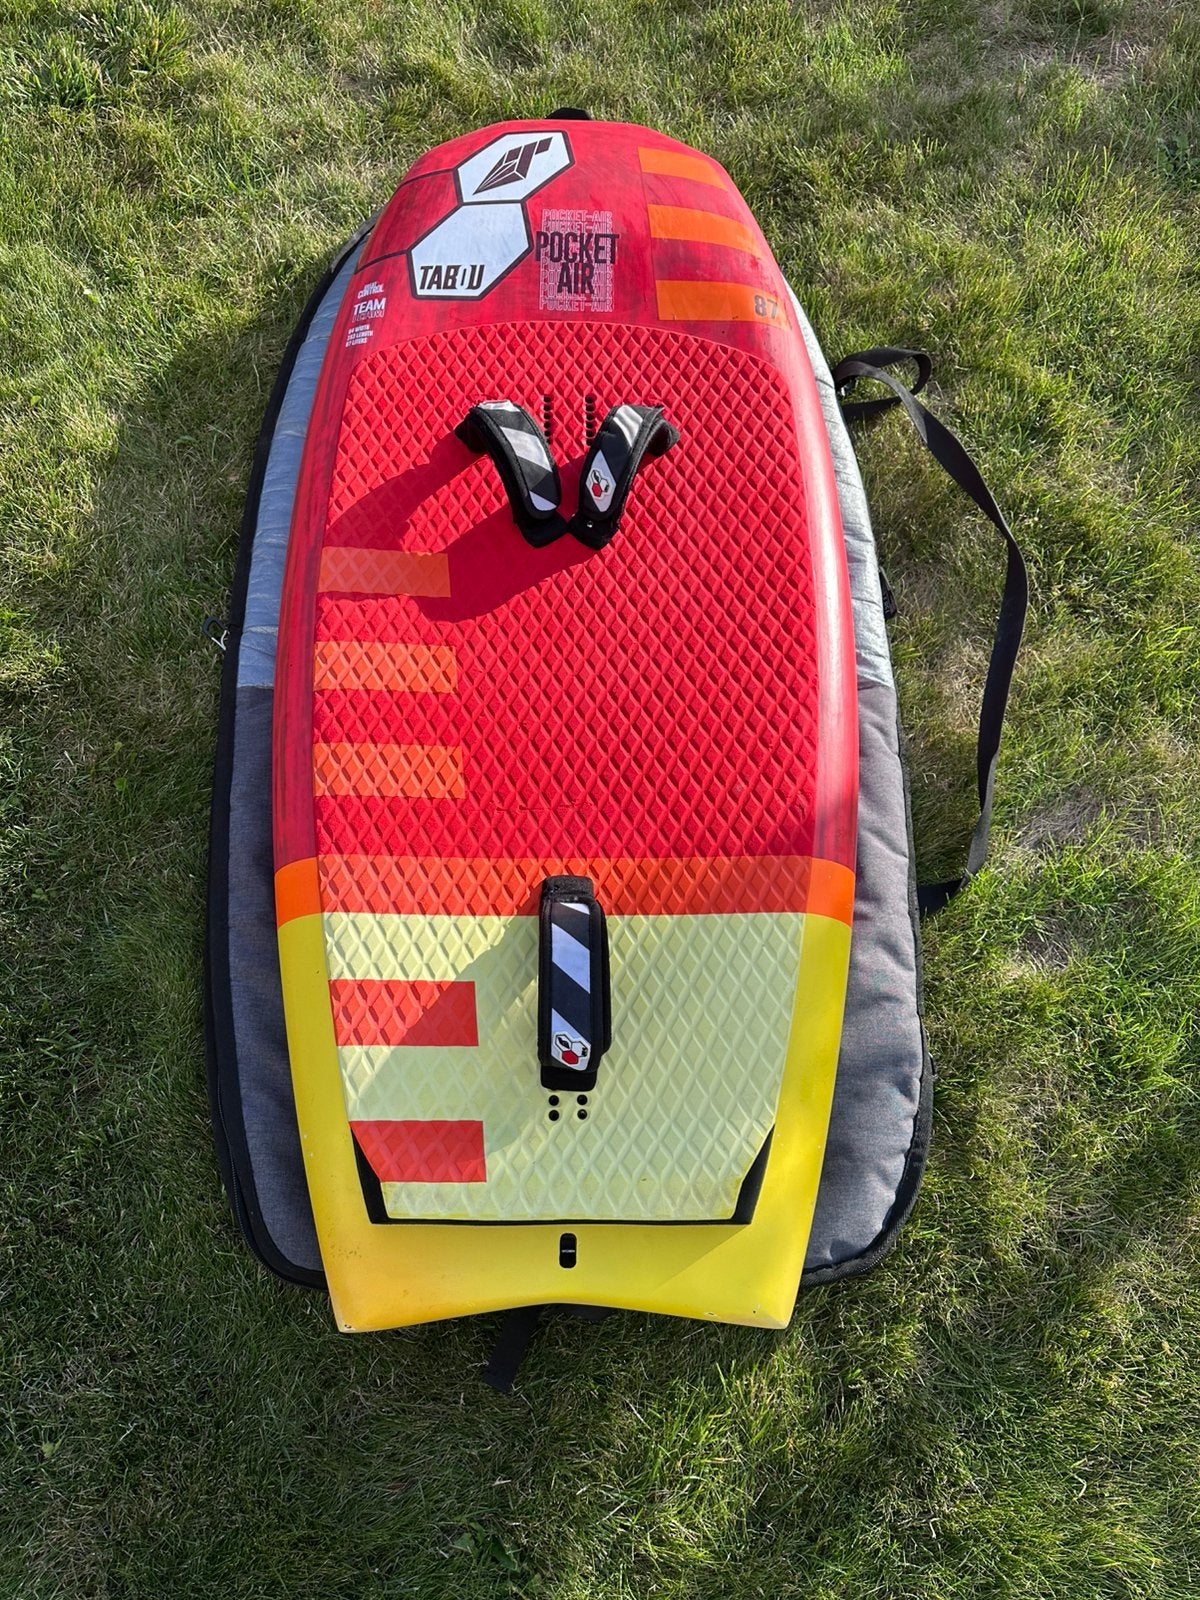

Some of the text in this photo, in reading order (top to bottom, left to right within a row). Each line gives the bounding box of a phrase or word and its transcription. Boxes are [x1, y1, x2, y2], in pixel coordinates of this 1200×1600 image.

[535, 230, 620, 265] POCKET
[419, 264, 485, 290] TABOU
[557, 261, 595, 295] AIR
[353, 297, 387, 316] TEAM
[754, 294, 778, 320] 87
